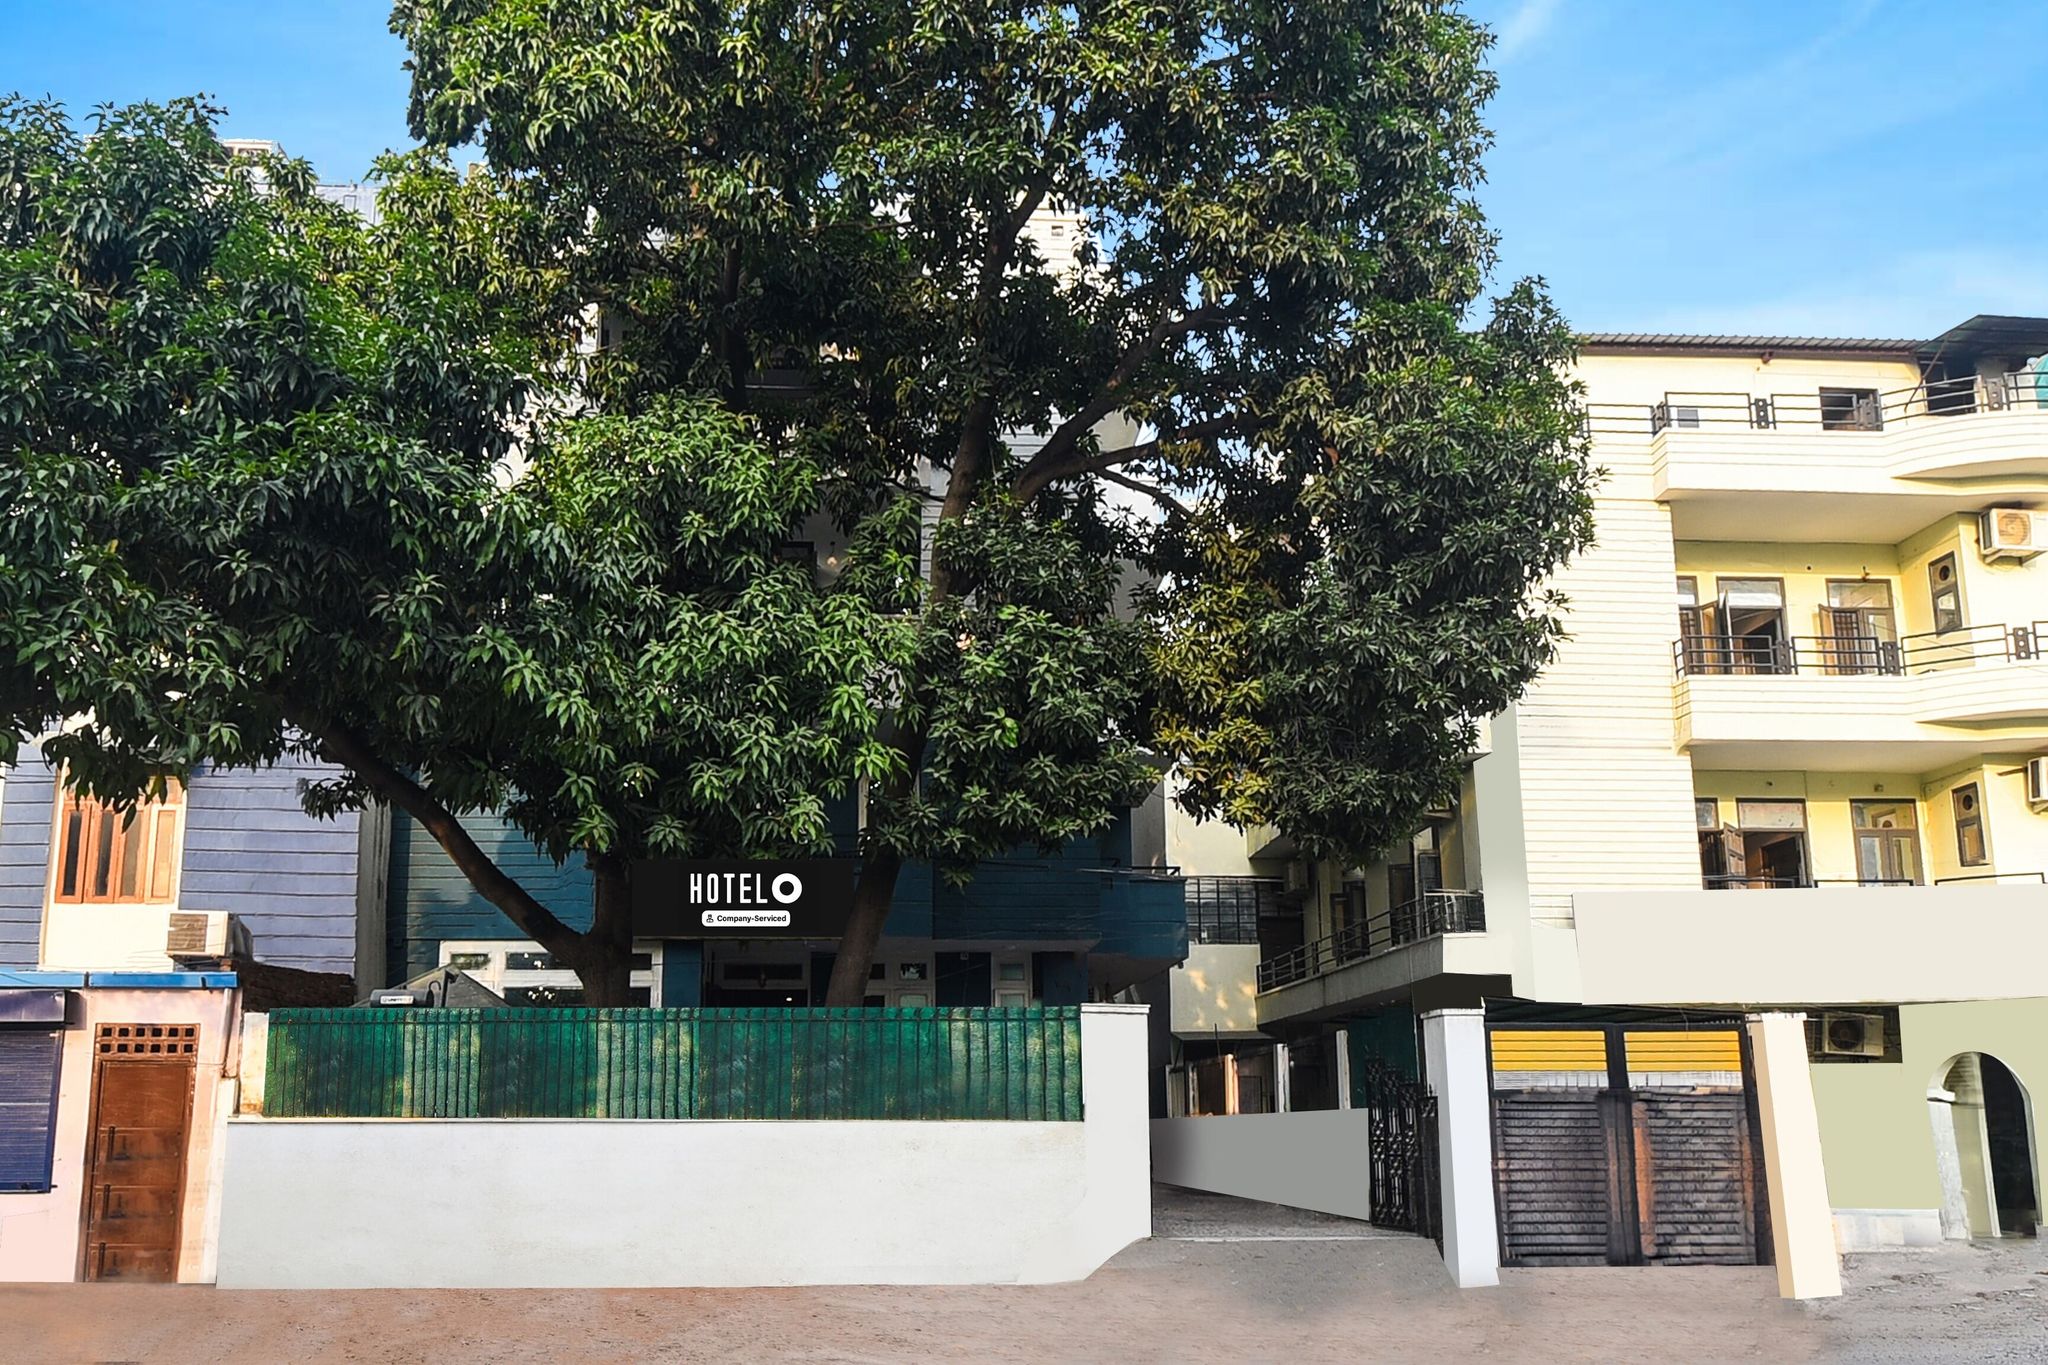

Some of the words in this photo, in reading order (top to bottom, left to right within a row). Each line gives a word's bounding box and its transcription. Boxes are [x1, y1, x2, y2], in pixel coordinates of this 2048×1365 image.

[690, 873, 768, 904] HOTEL
[771, 873, 803, 904] O
[716, 914, 787, 924] Company-Serviced
